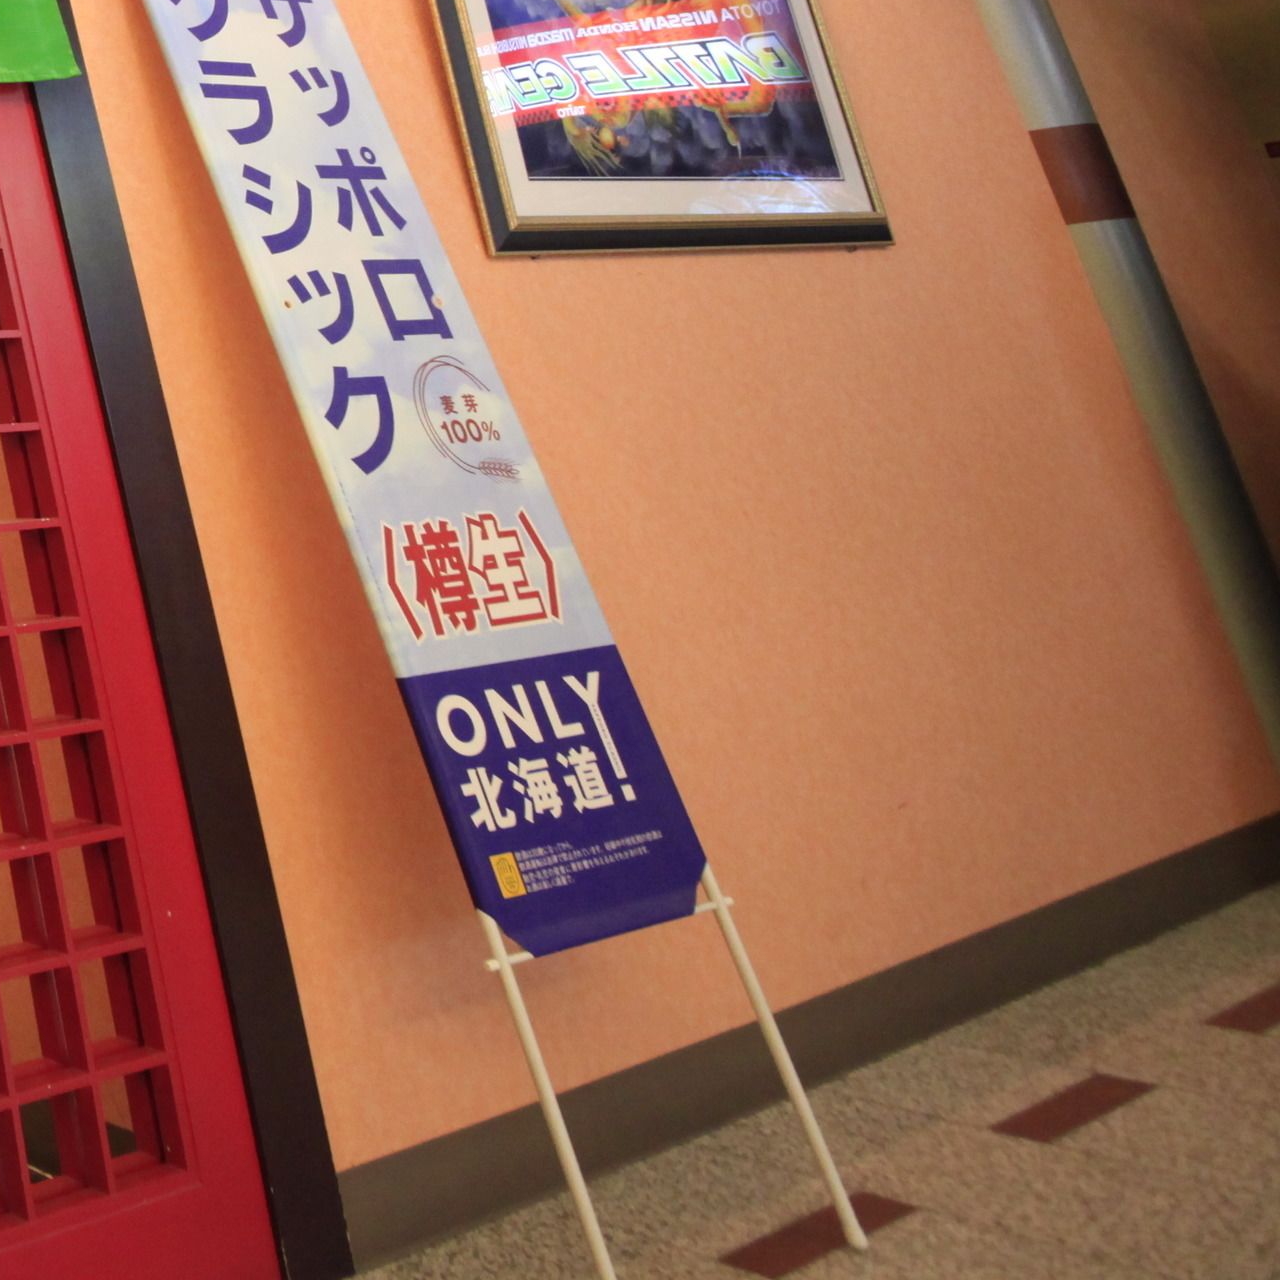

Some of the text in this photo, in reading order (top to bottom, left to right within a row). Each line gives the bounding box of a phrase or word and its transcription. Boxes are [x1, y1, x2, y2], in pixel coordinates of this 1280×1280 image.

[440, 394, 479, 415] 麦芽
[440, 418, 502, 445] 100%
[436, 671, 612, 760] ONLY
